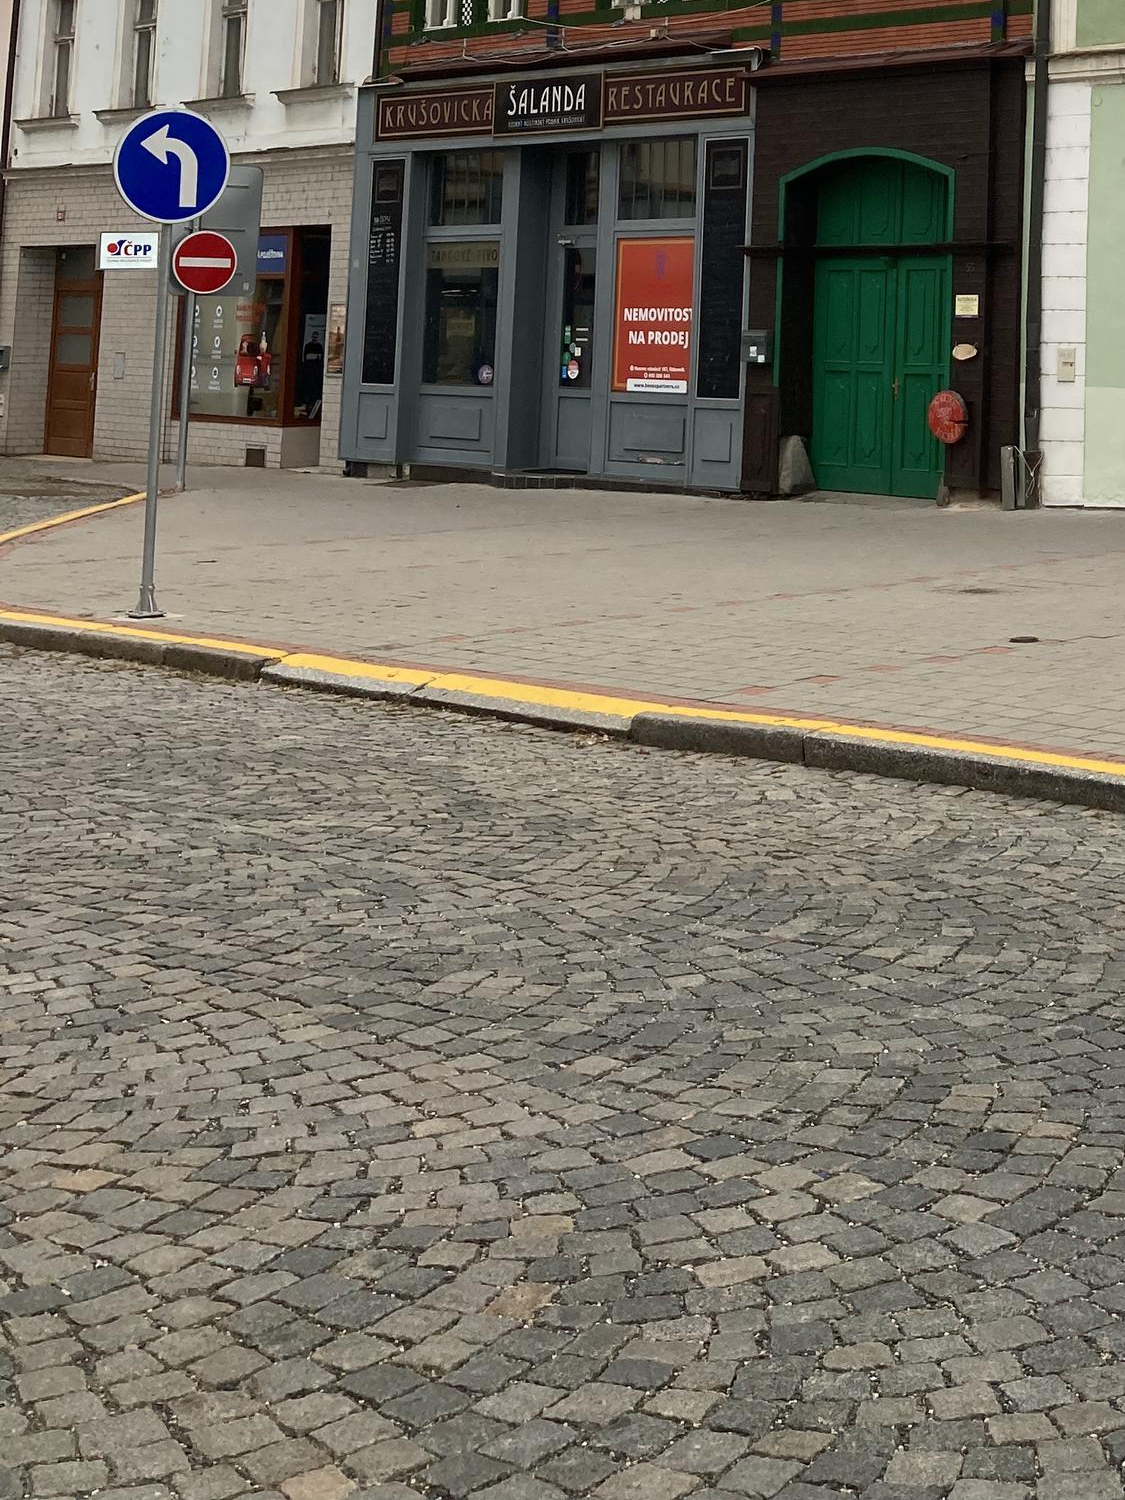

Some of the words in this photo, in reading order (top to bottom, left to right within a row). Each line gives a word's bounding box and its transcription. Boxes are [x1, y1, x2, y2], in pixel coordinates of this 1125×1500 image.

[507, 83, 586, 116] ŠALANDA
[608, 77, 736, 111] RESTAURACE
[385, 94, 492, 128] KRUŠOVICKÁ
[123, 240, 152, 256] ČPP
[624, 307, 692, 322] NEMOVITOST
[628, 331, 645, 345] NA
[647, 331, 689, 349] PRODEJ
